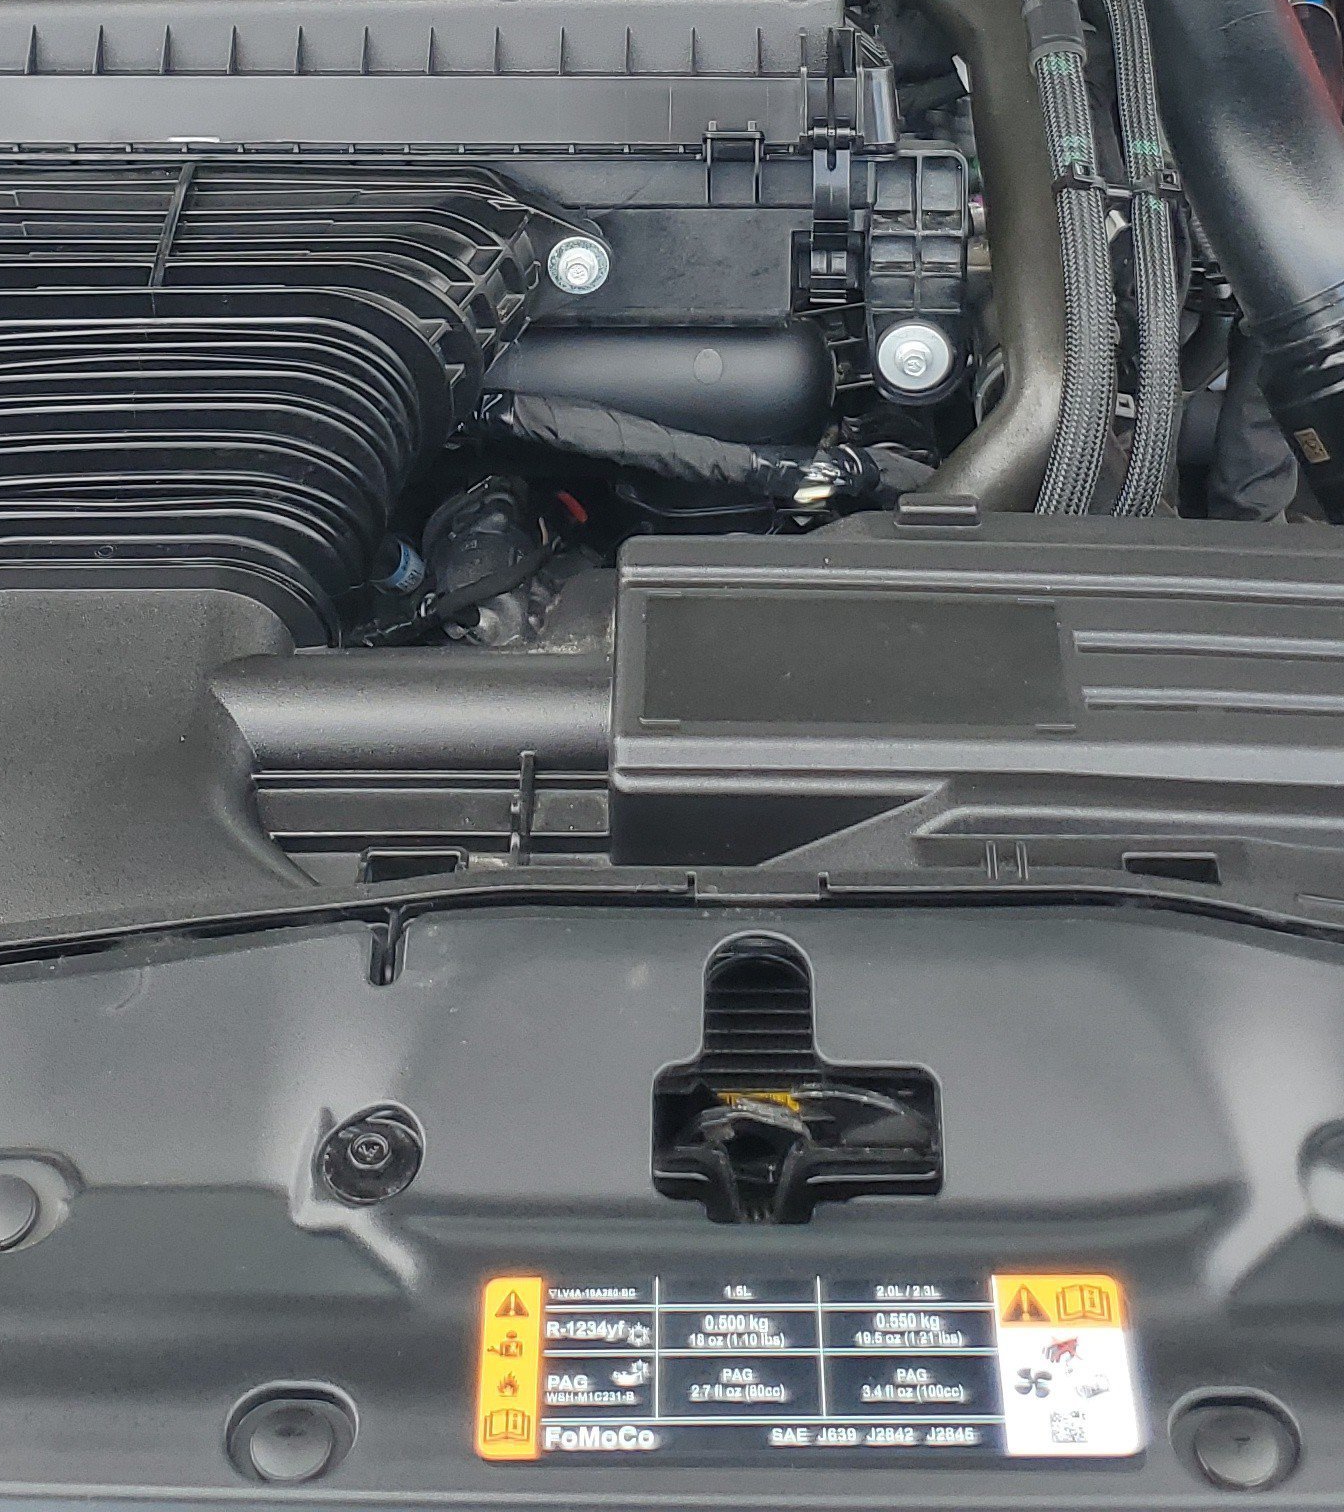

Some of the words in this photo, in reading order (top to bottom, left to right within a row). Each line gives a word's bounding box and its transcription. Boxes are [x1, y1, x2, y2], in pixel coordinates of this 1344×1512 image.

[877, 1285, 904, 1297] 2.0L
[912, 1285, 939, 1297] 2.3L
[704, 1314, 745, 1331] 0.500
[749, 1314, 769, 1333] kg
[876, 1313, 916, 1329] 0.550
[920, 1312, 940, 1332] kg
[546, 1320, 625, 1341] R-1234yf
[885, 1333, 902, 1344] oz
[708, 1336, 724, 1346] oz
[726, 1333, 758, 1348] (1.10
[761, 1332, 785, 1348] lbs)
[548, 1374, 588, 1390] PAG
[722, 1368, 753, 1381] PAG
[896, 1368, 927, 1381] PAG
[691, 1384, 711, 1398] 2.7
[714, 1384, 723, 1397] fl
[726, 1387, 742, 1397] oz
[745, 1383, 785, 1401] (80cc)
[862, 1384, 883, 1398] 3.4
[897, 1387, 913, 1397] oz
[916, 1383, 964, 1402] (100cc)
[545, 1425, 655, 1450] FoMoCo
[771, 1427, 807, 1441] SAE
[817, 1427, 856, 1441] J639
[866, 1427, 914, 1441] J2842
